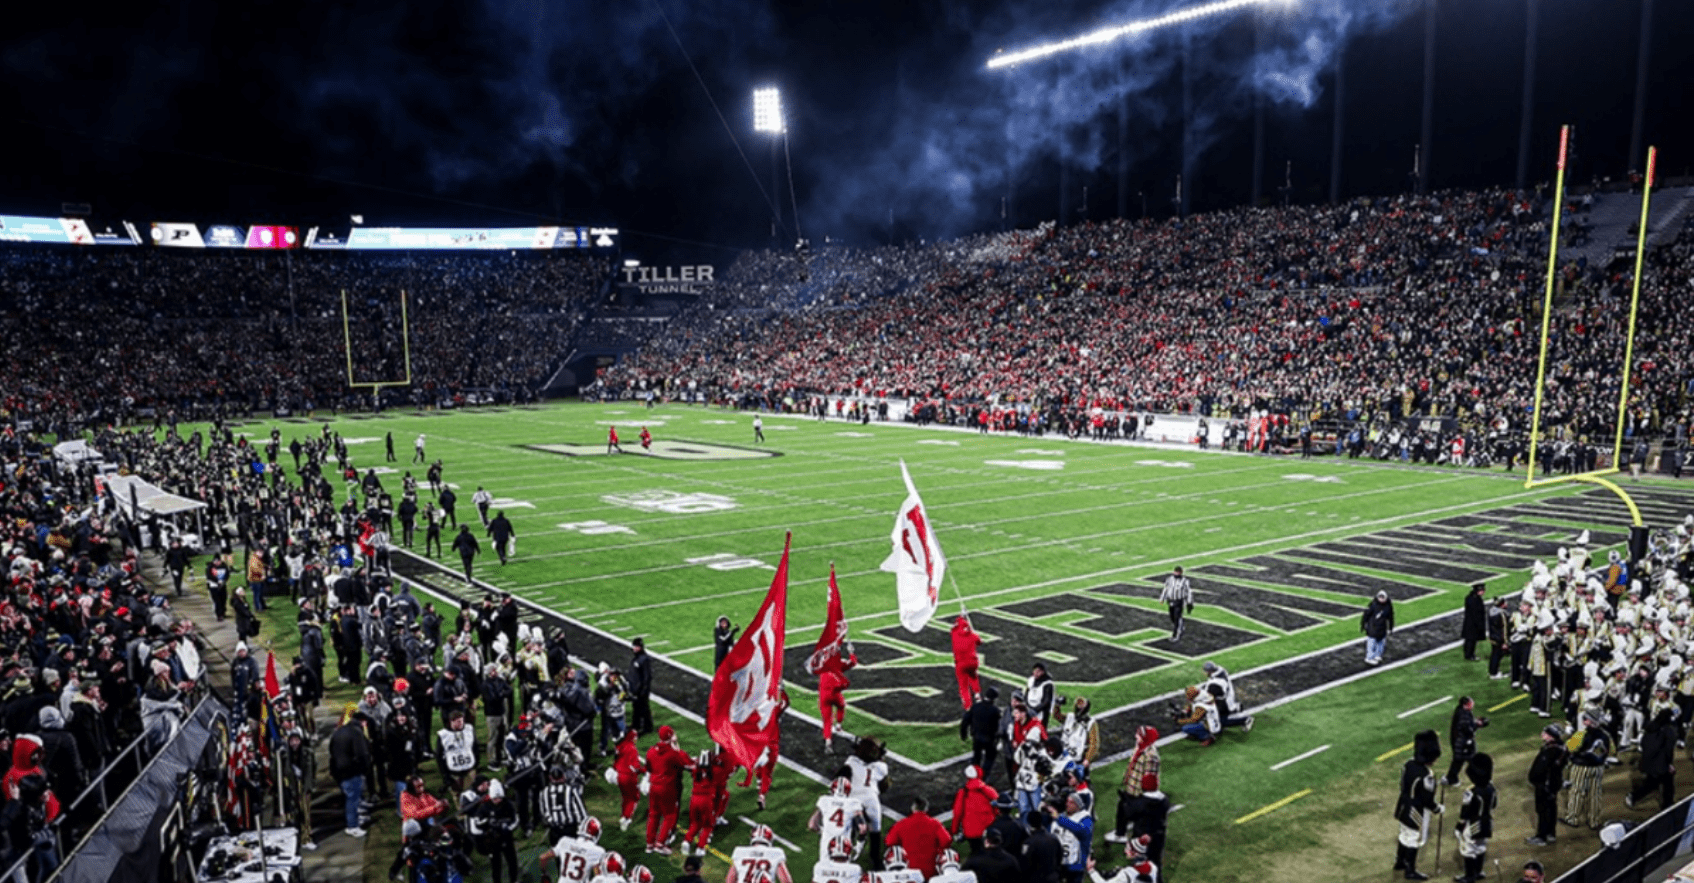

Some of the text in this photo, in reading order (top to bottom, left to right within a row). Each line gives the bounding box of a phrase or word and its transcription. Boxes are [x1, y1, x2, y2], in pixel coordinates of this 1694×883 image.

[621, 265, 714, 283] TILLER
[639, 284, 701, 294] TUNNEL
[864, 768, 873, 788] 1
[829, 808, 845, 829] 4
[561, 852, 587, 881] 13
